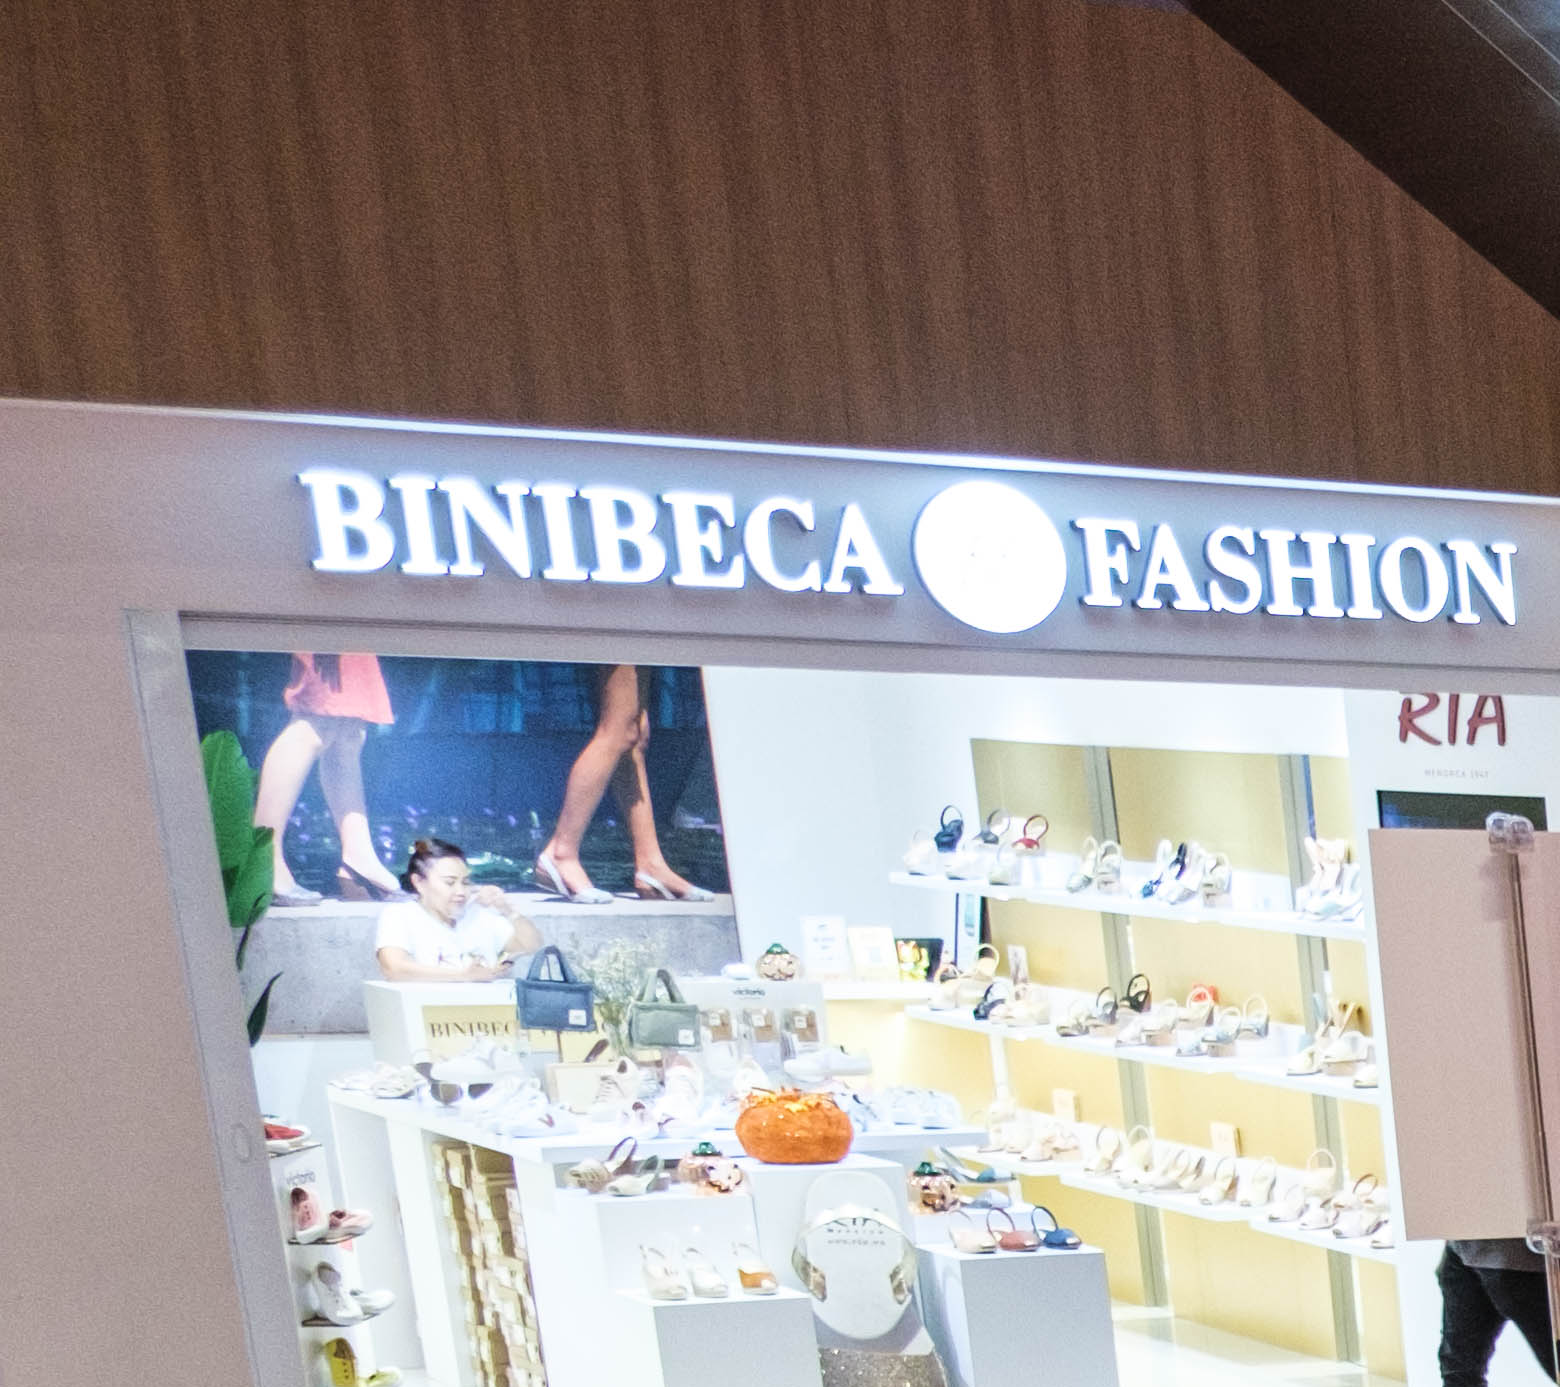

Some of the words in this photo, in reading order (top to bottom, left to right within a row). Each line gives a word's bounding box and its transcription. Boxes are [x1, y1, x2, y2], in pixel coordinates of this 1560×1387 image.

[297, 467, 904, 597] BINIBECA
[1073, 516, 1519, 627] FASHION
[429, 1021, 515, 1040] BINIBEC
